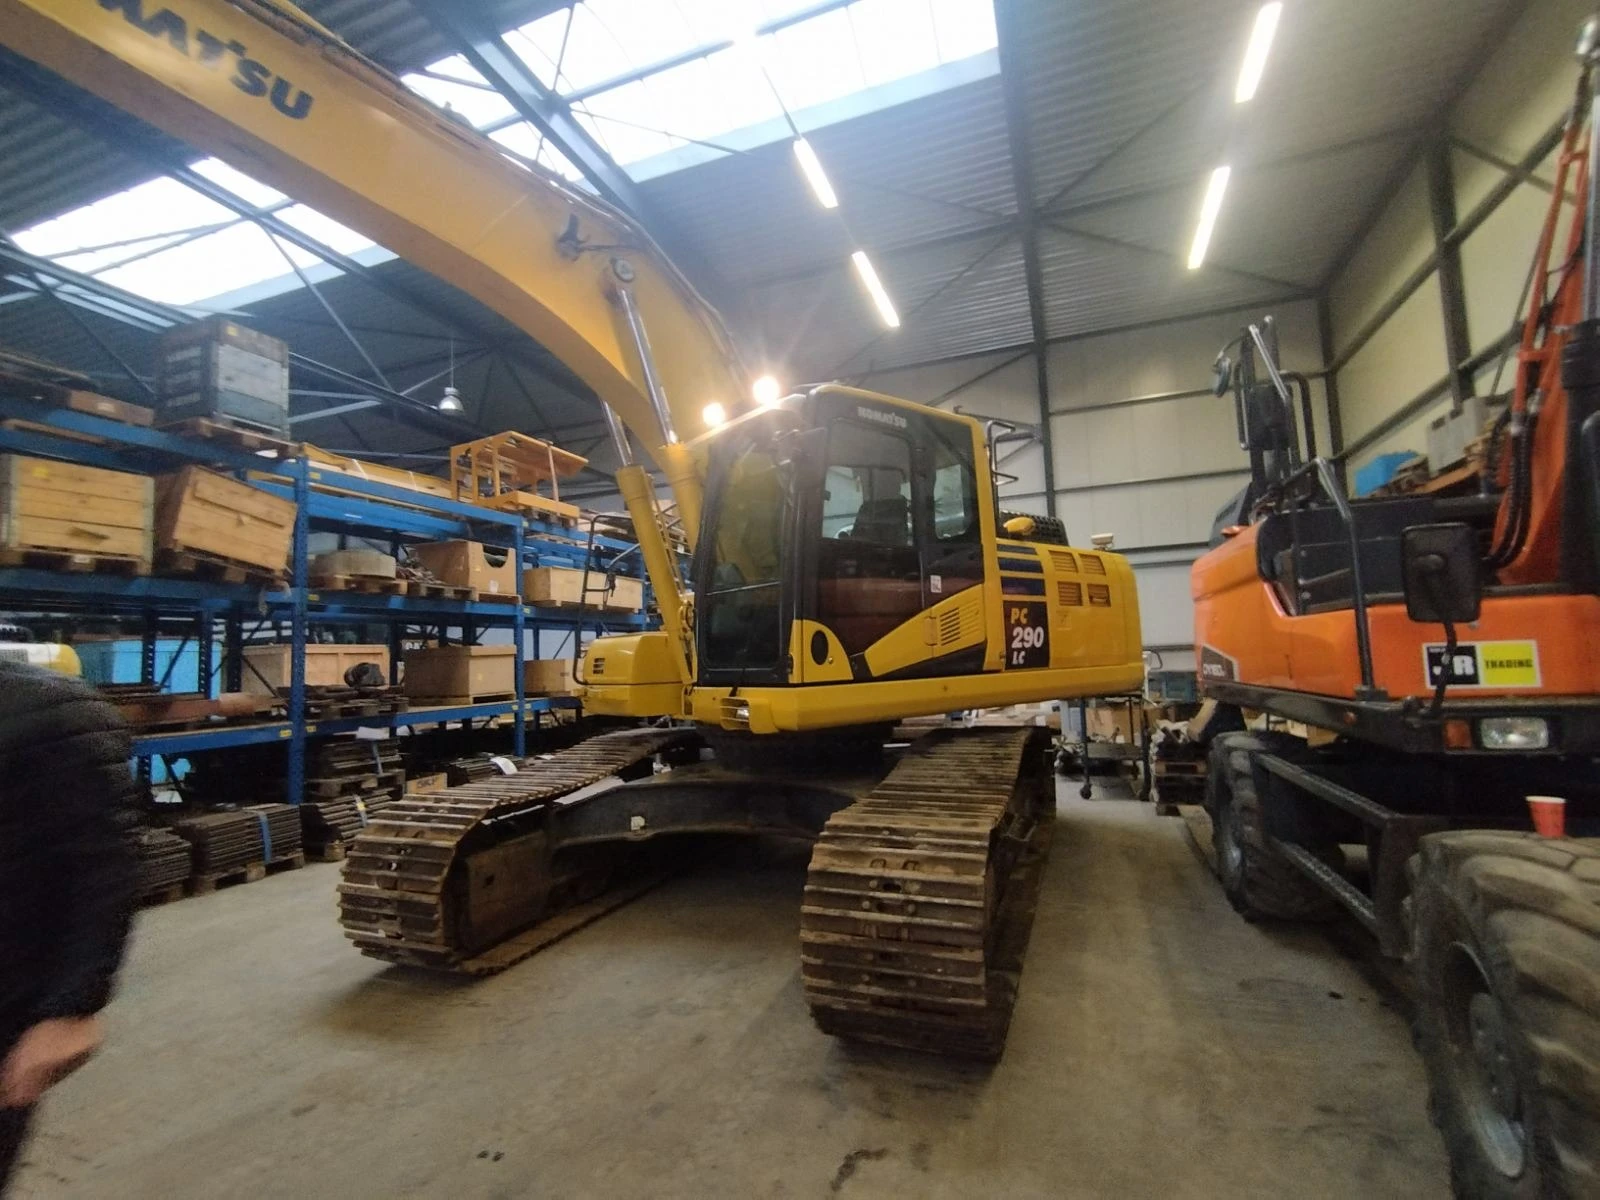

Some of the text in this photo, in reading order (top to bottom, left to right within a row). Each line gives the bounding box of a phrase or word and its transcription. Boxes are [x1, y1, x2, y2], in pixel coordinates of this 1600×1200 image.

[1010, 607, 1029, 625] PC
[1011, 626, 1045, 649] 290
[1012, 650, 1026, 665] LC
[1485, 658, 1533, 669] TRADING
